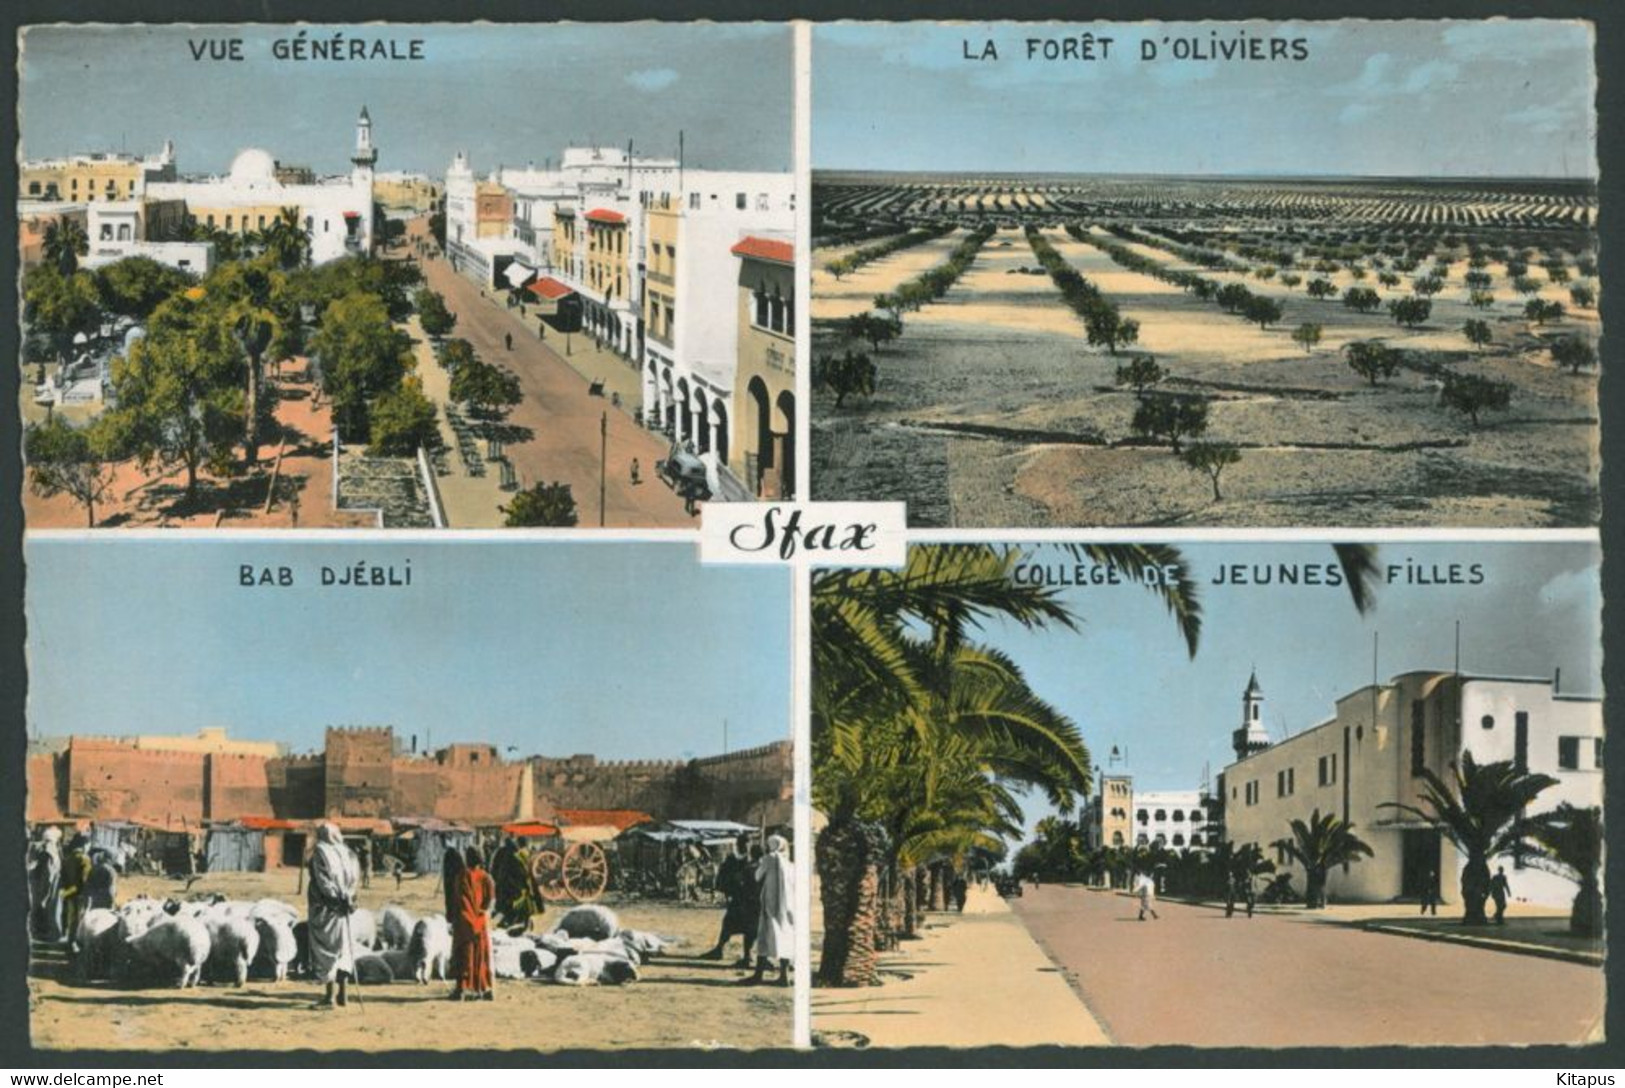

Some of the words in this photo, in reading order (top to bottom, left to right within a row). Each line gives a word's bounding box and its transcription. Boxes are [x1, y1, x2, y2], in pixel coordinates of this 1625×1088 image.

[188, 39, 244, 61] VUE
[272, 30, 426, 61] GÉNÉRALE
[963, 39, 999, 61] LA
[1026, 32, 1114, 61] FORÊT
[729, 506, 877, 560] Sfax
[239, 565, 294, 587] BAB
[1142, 564, 1180, 587] DE
[1211, 564, 1343, 586] JEUNES
